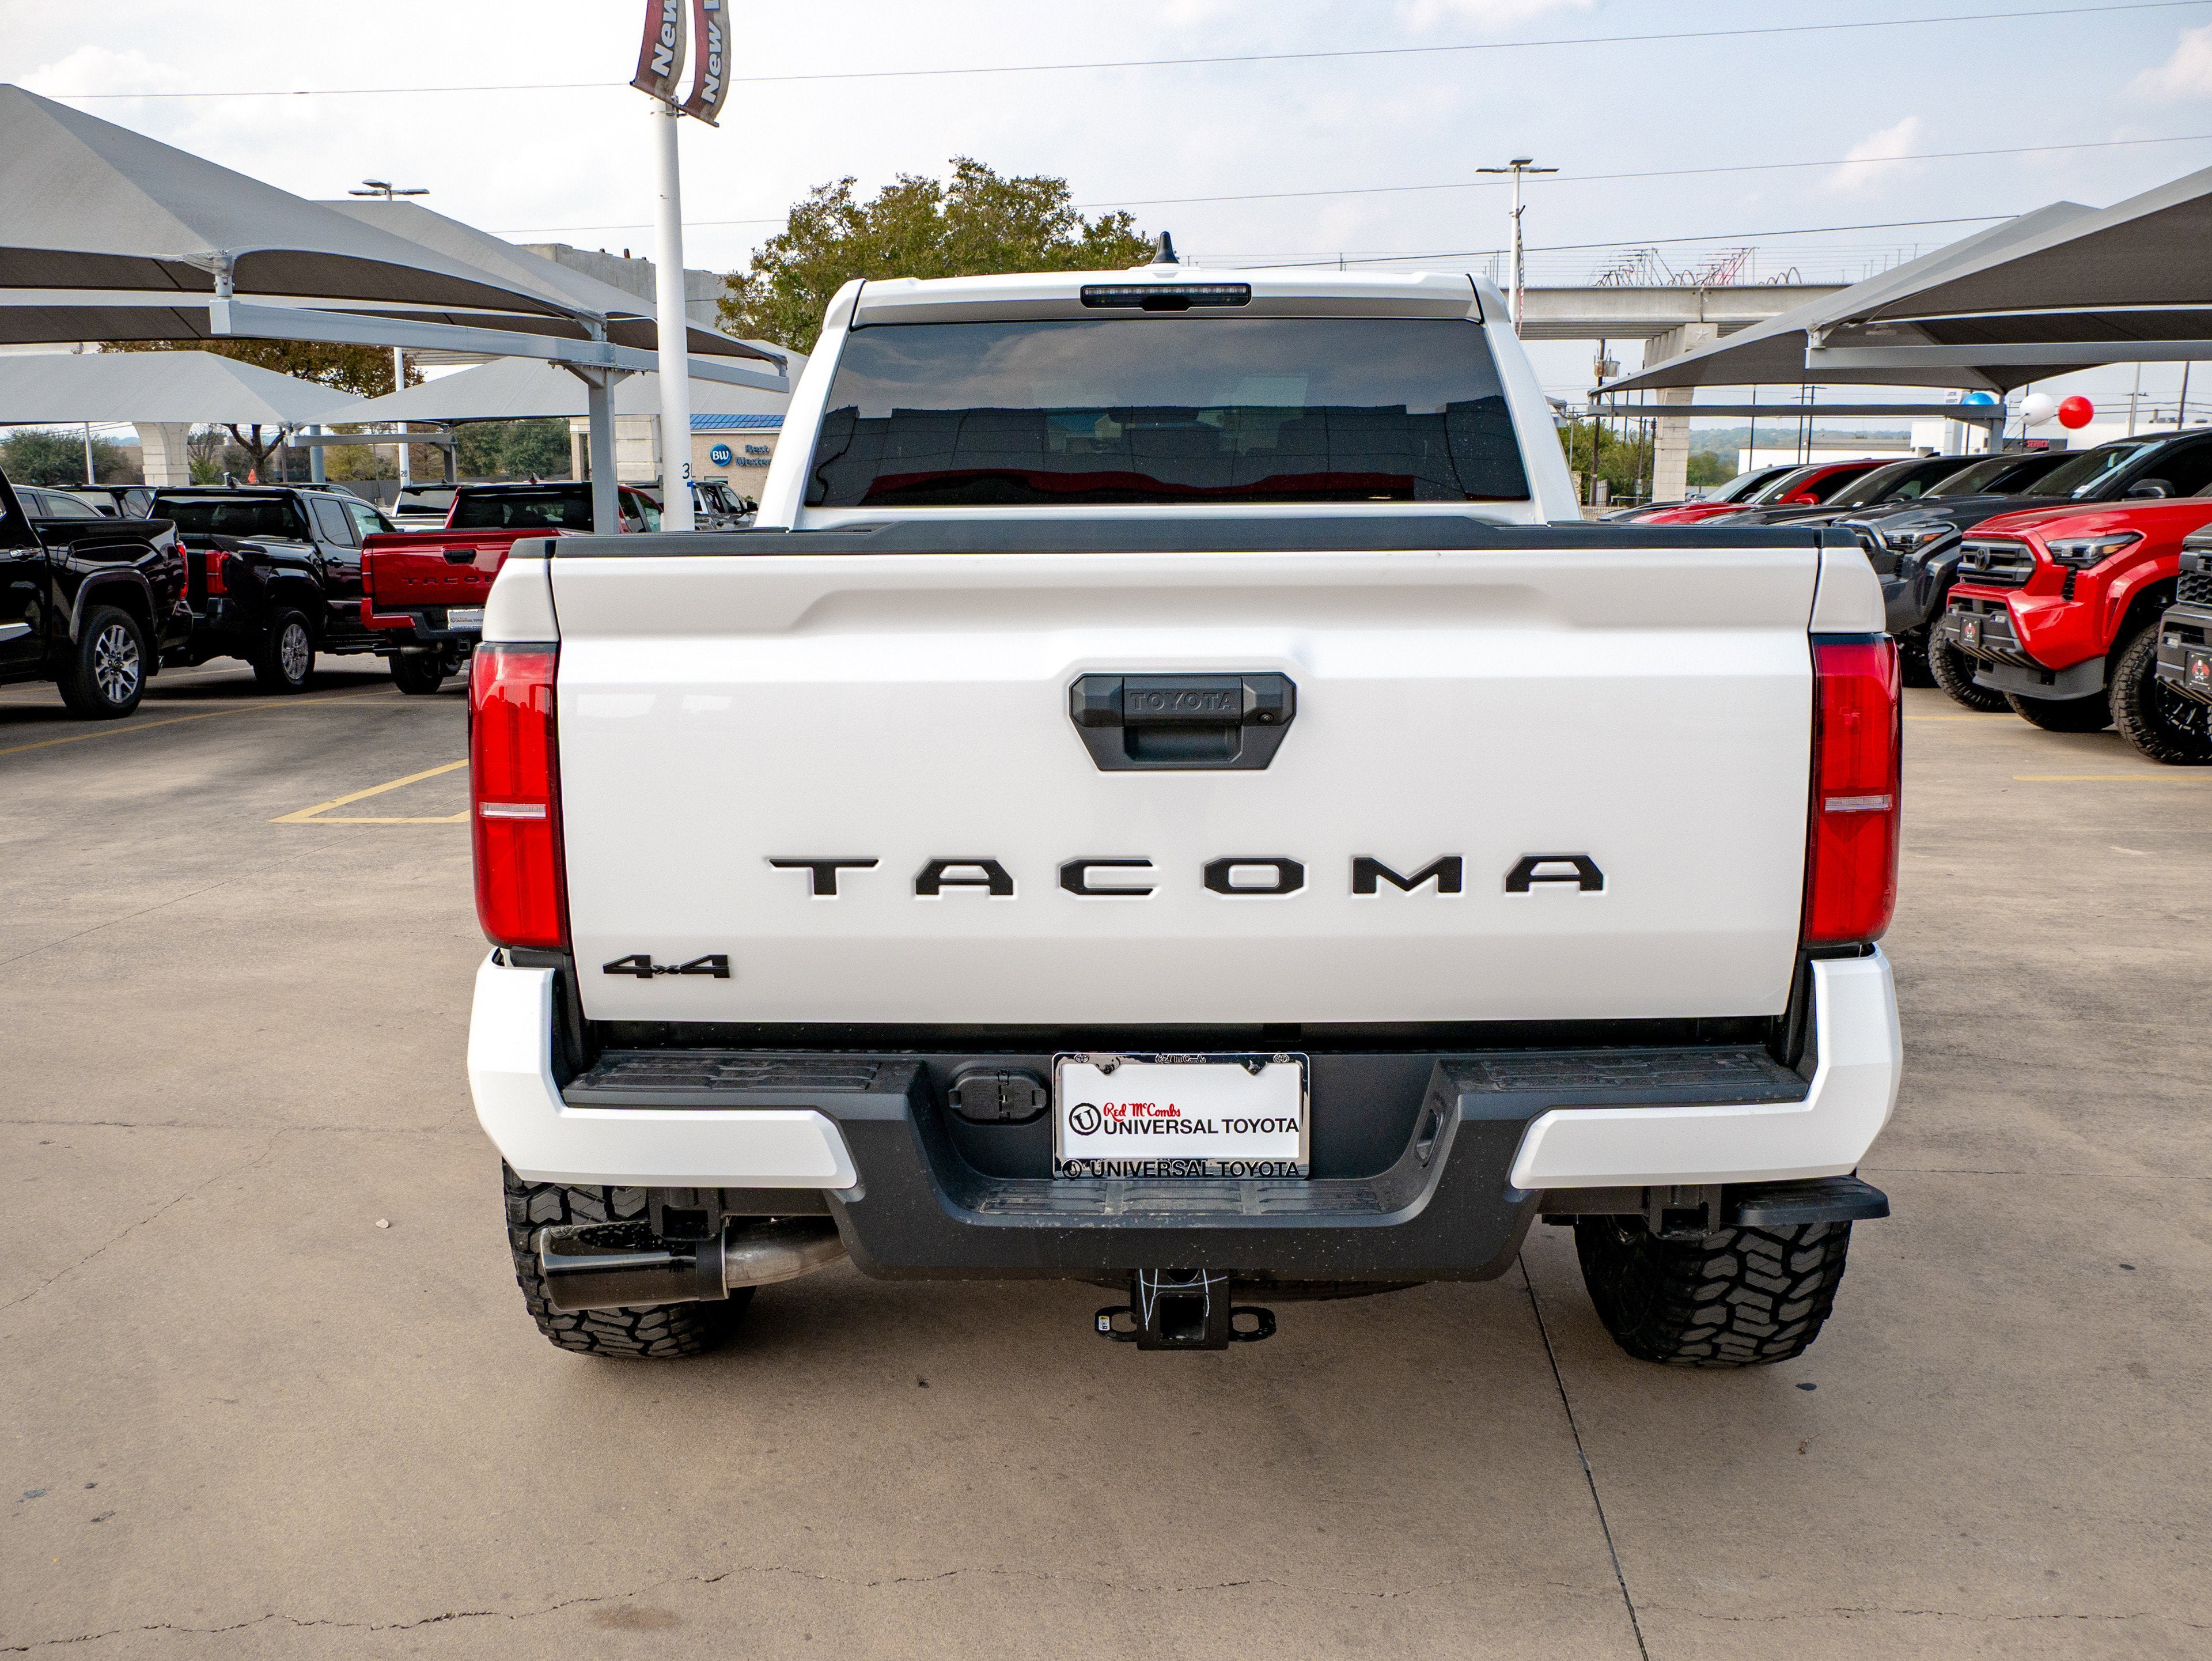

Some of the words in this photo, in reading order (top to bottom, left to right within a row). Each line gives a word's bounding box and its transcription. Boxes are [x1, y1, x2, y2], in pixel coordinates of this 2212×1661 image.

[650, 0, 677, 77] New
[701, 20, 721, 104] New
[712, 451, 729, 460] BW
[745, 445, 770, 455] Best
[736, 457, 772, 467] Wester
[682, 463, 692, 479] 3
[402, 576, 497, 585] TACOM
[1130, 692, 1236, 711] TOYOTA
[768, 855, 1604, 895] TACOMA
[603, 954, 730, 979] 4x4
[1155, 1053, 1172, 1064] Red
[1103, 1102, 1126, 1122] Red
[1128, 1103, 1181, 1117] McCombs
[1104, 1119, 1218, 1134] UNIVERSAL
[1221, 1118, 1300, 1134] TOYOTA
[1091, 1160, 1214, 1177] UNIVERSAL
[1216, 1160, 1300, 1177] TOYOTA
